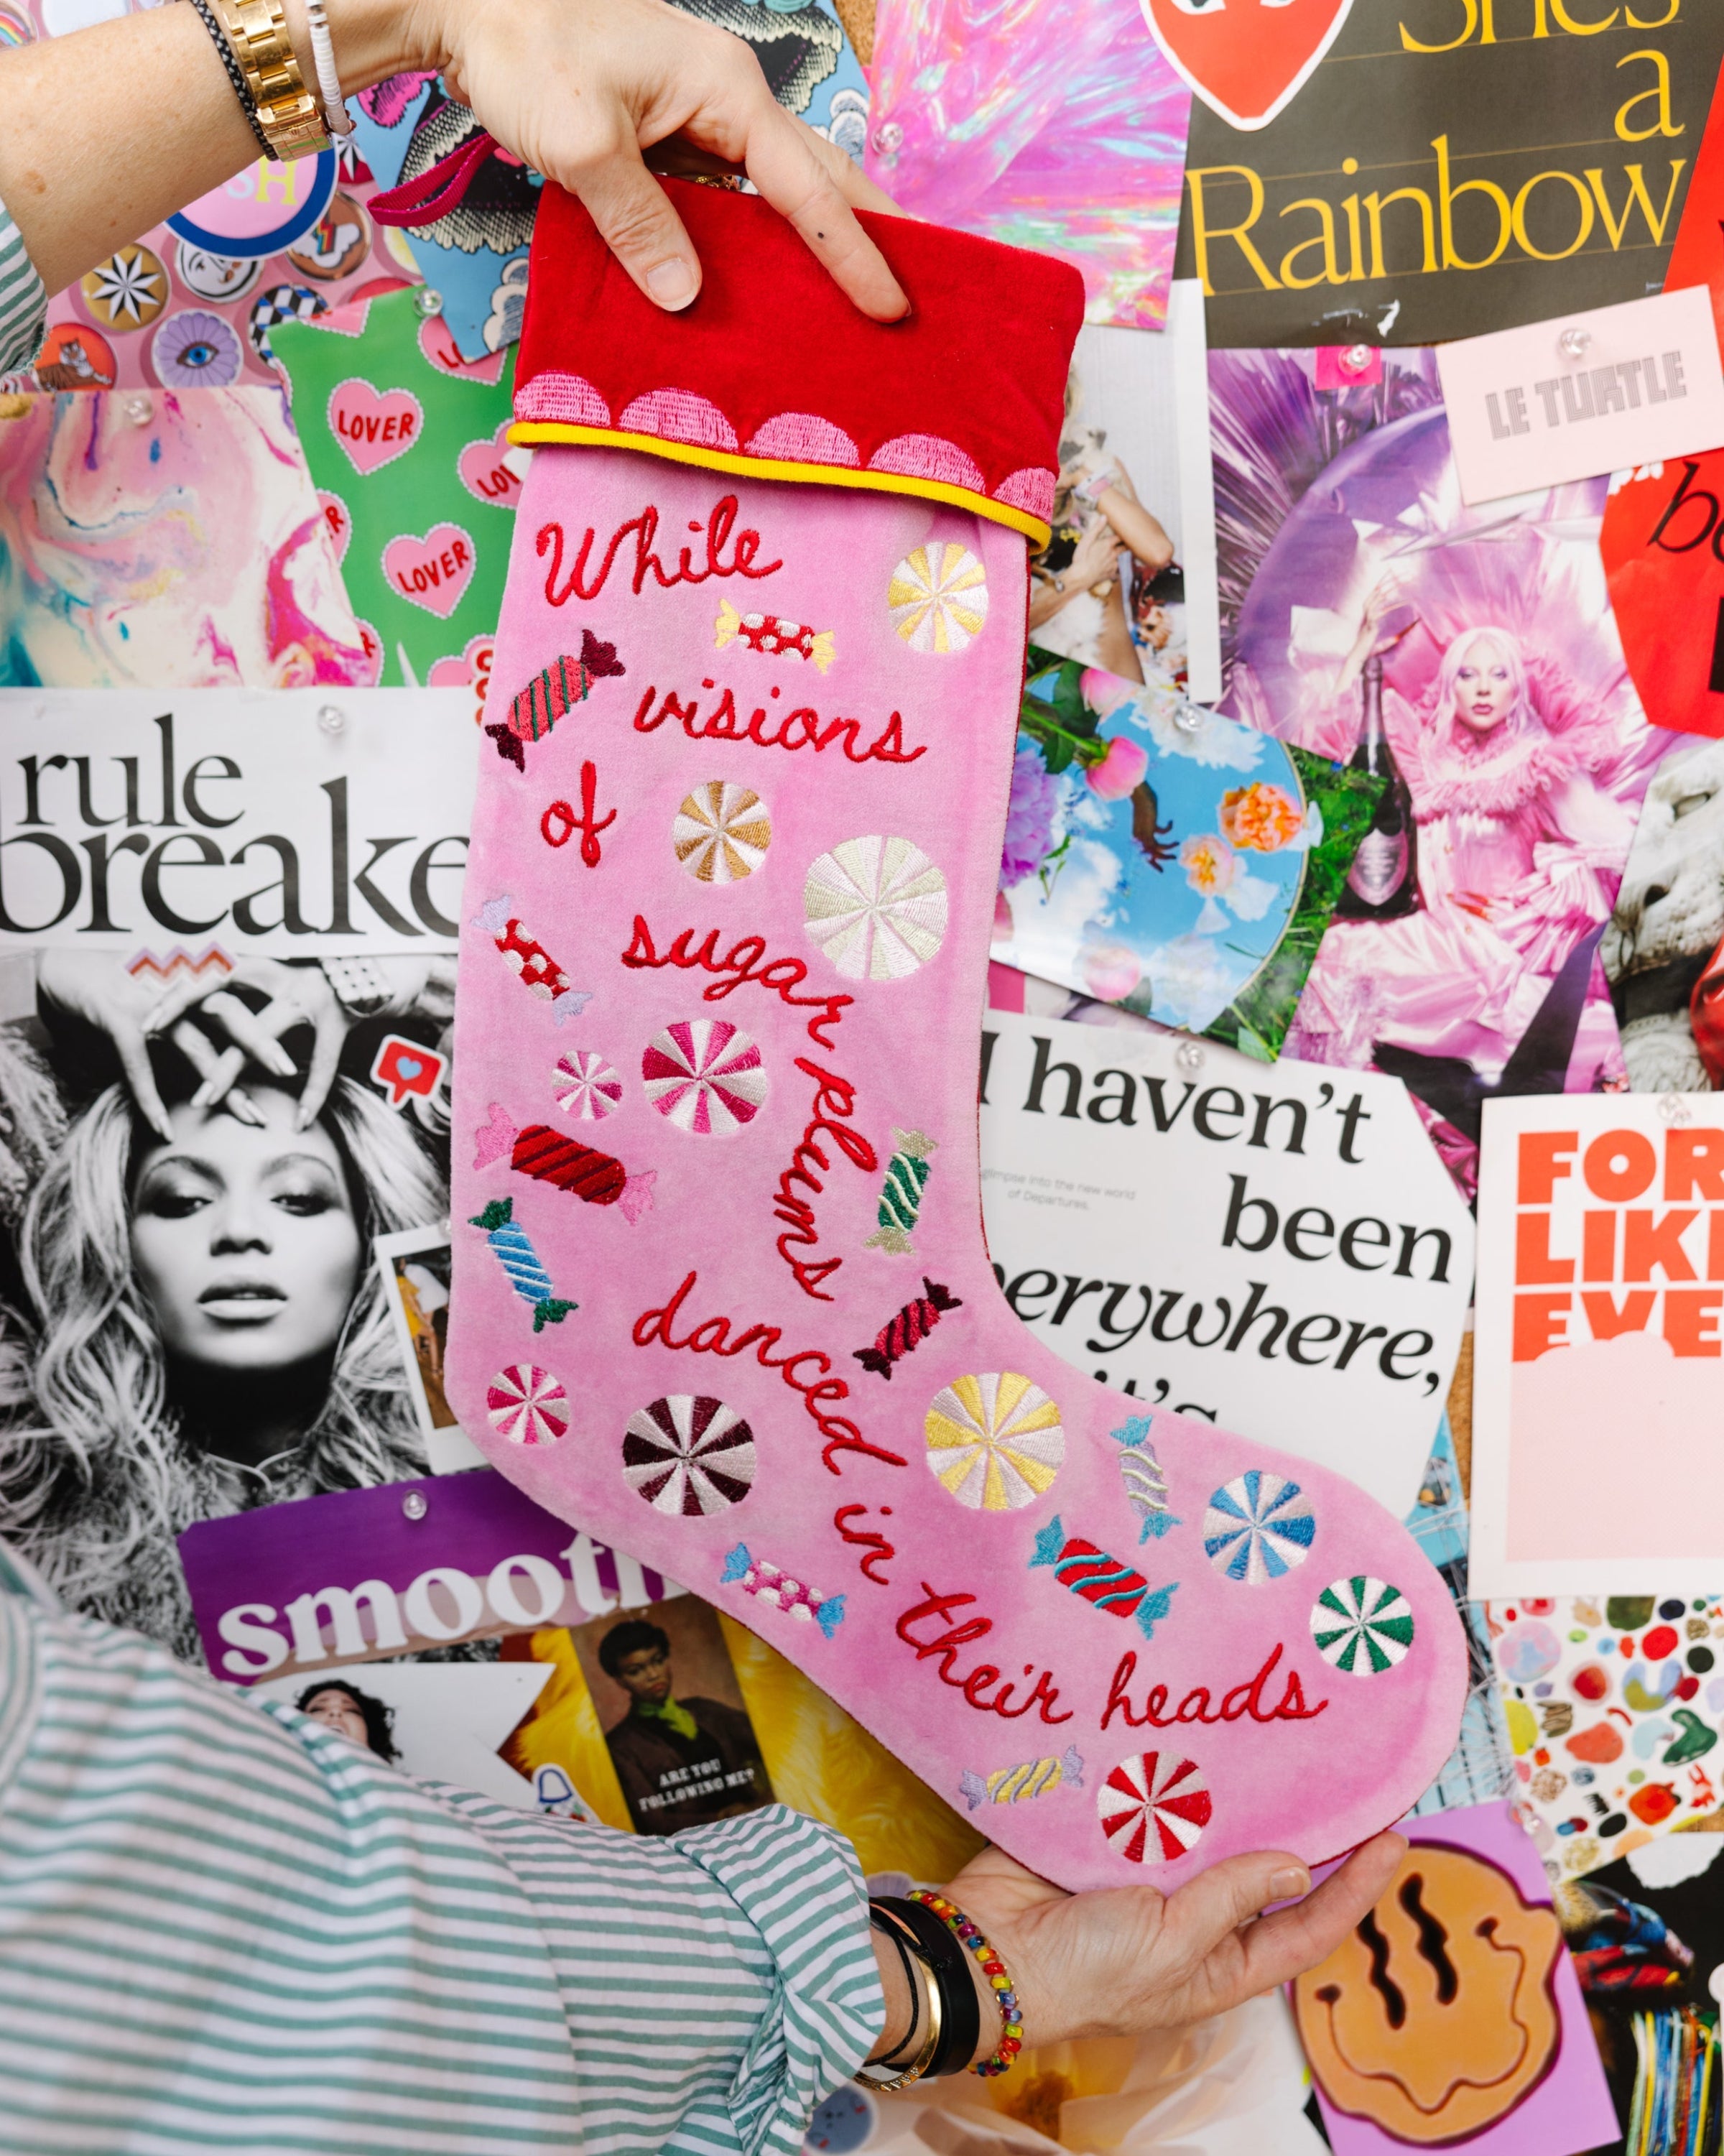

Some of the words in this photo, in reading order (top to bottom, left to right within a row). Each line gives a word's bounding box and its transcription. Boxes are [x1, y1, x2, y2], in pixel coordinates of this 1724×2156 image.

[1615, 50, 1685, 142] a
[1186, 134, 1687, 297] Rainbow
[338, 410, 414, 443] LOVER
[1485, 387, 1530, 440] LE
[1534, 351, 1687, 427] TURTLE
[397, 540, 469, 593] LOVER
[537, 494, 783, 606] While
[634, 679, 927, 763] visions
[16, 713, 245, 828] rule
[540, 761, 617, 868] of
[621, 915, 855, 1050] sugar
[774, 1057, 878, 1301] plums
[1008, 1190, 1020, 1199] of
[1055, 1179, 1075, 1190] the
[1221, 1174, 1451, 1284] been
[632, 1271, 908, 1476] danced
[834, 1504, 895, 1585] in
[896, 1582, 1073, 1724] their
[1100, 1643, 1329, 1730] heads
[639, 1777, 725, 1813] FOLLOWING
[725, 1768, 754, 1787] ME?
[659, 1767, 690, 1787] ARE
[690, 1758, 721, 1778] YOU
